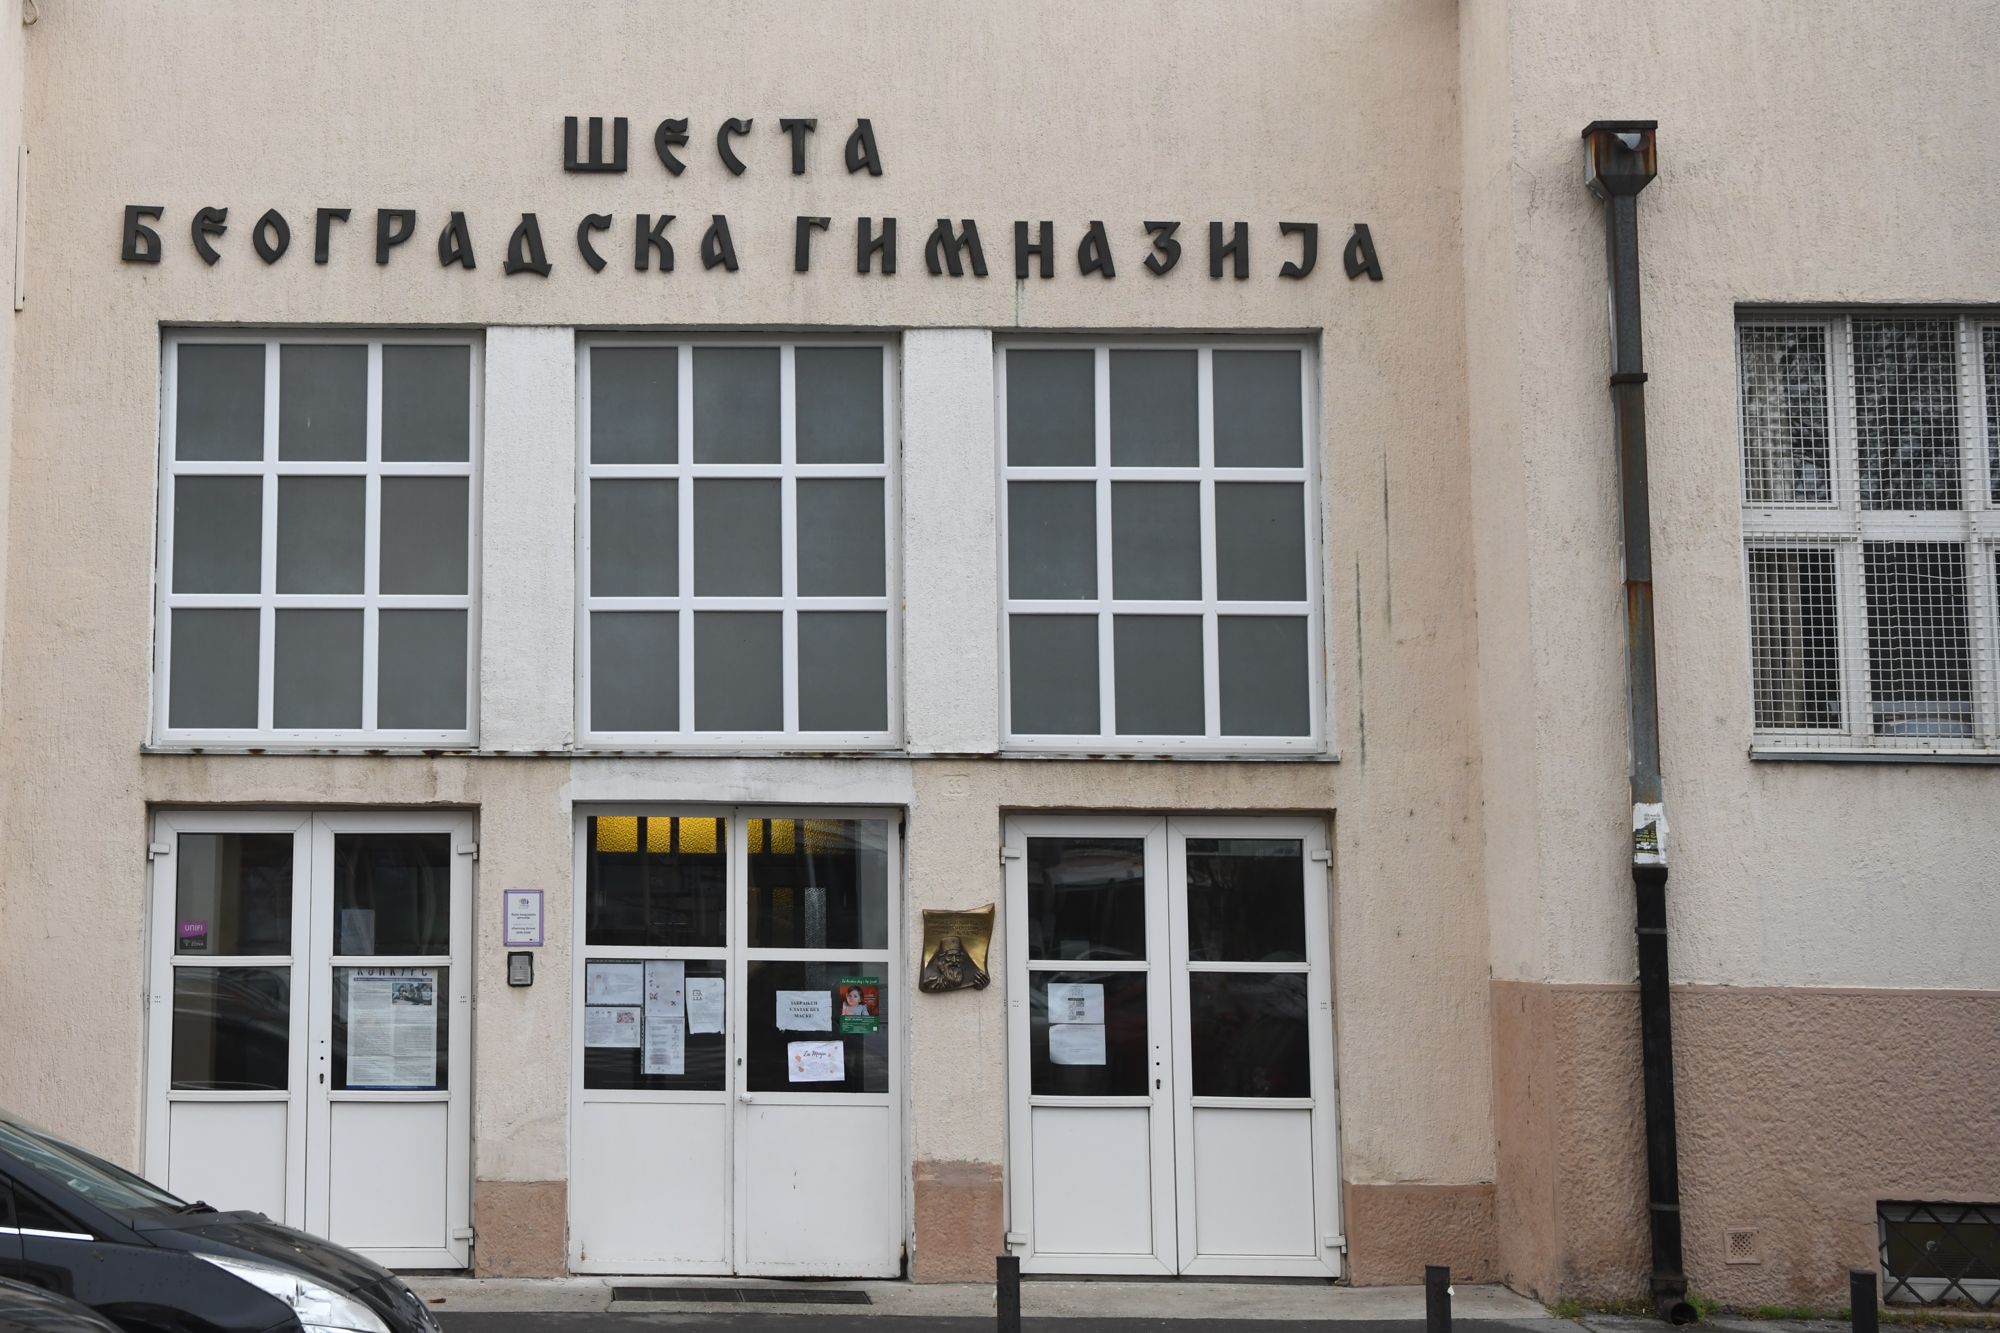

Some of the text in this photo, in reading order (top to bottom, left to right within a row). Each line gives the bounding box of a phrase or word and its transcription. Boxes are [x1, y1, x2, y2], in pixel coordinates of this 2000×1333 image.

[564, 115, 884, 178] ШЕСТА
[121, 204, 1384, 284] БЕОГРАДСКА ГИМНАЗИЈА
